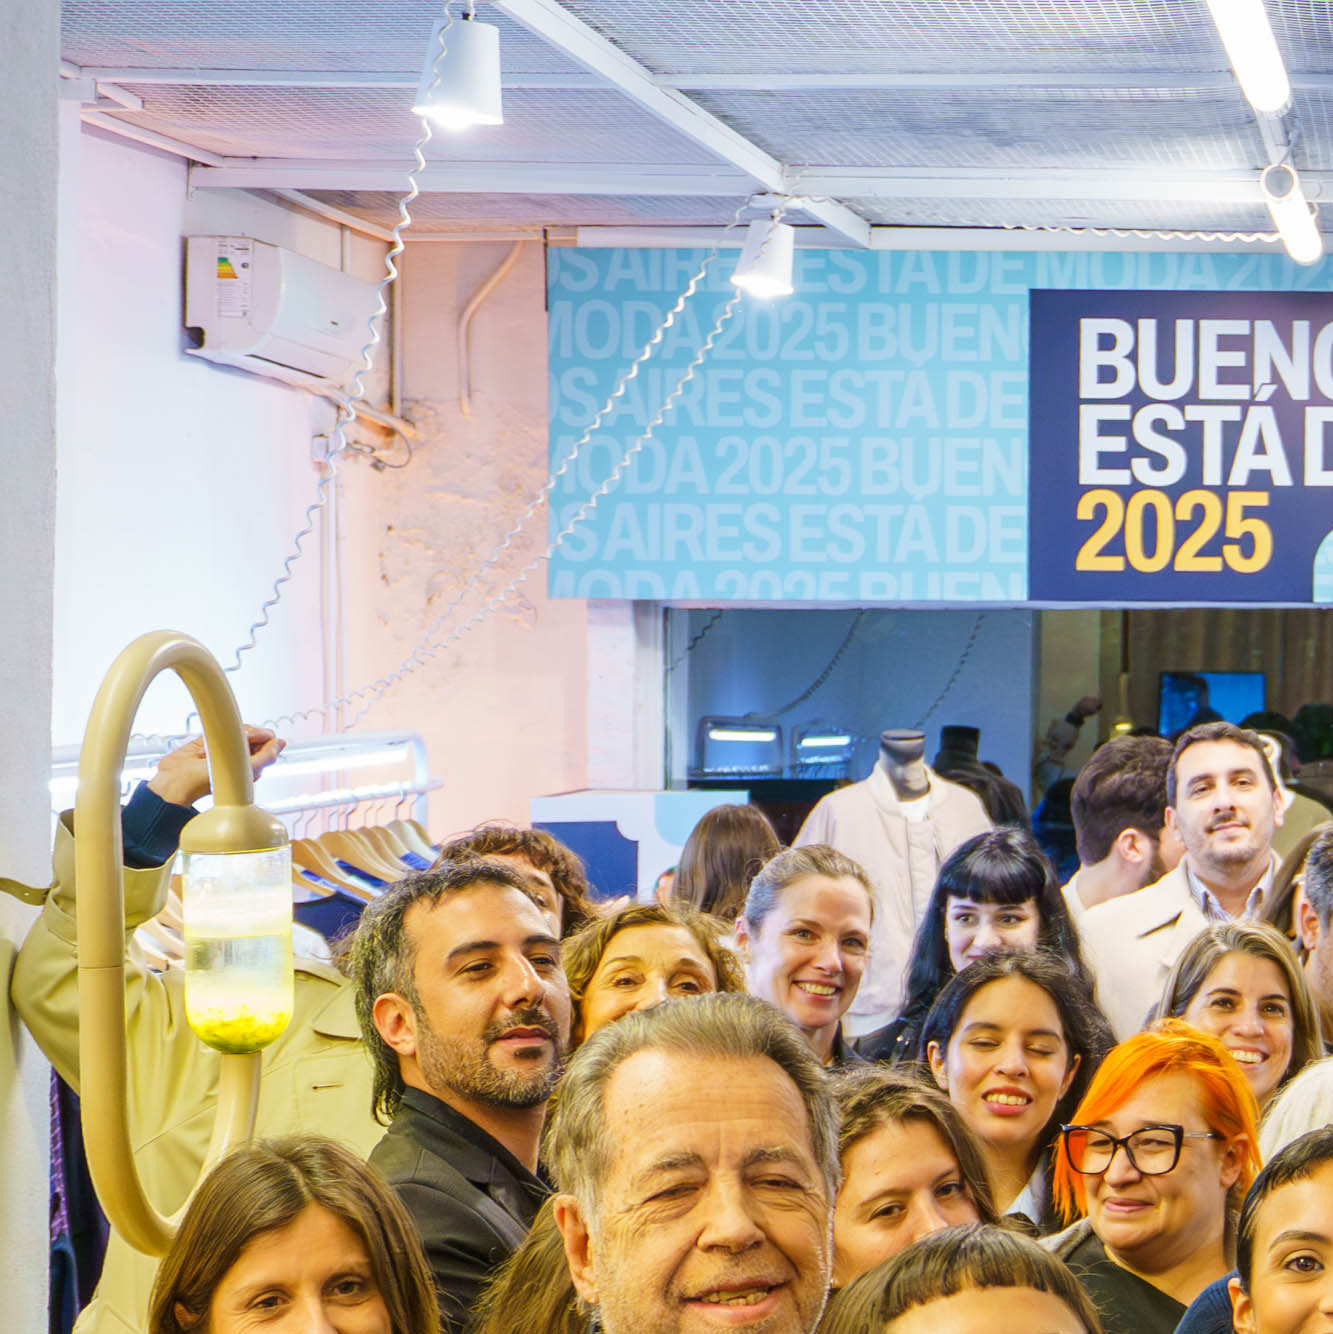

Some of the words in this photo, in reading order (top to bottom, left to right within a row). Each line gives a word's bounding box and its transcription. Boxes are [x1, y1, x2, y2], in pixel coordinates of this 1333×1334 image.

[712, 300, 850, 360] 2025
[602, 367, 783, 429] AIRES
[947, 369, 1026, 429] DE
[1078, 383, 1294, 487] ESTÁ
[714, 436, 851, 496] 2025
[602, 503, 783, 562] AIRES
[946, 504, 1025, 563] DE
[1076, 489, 1273, 573] 2025
